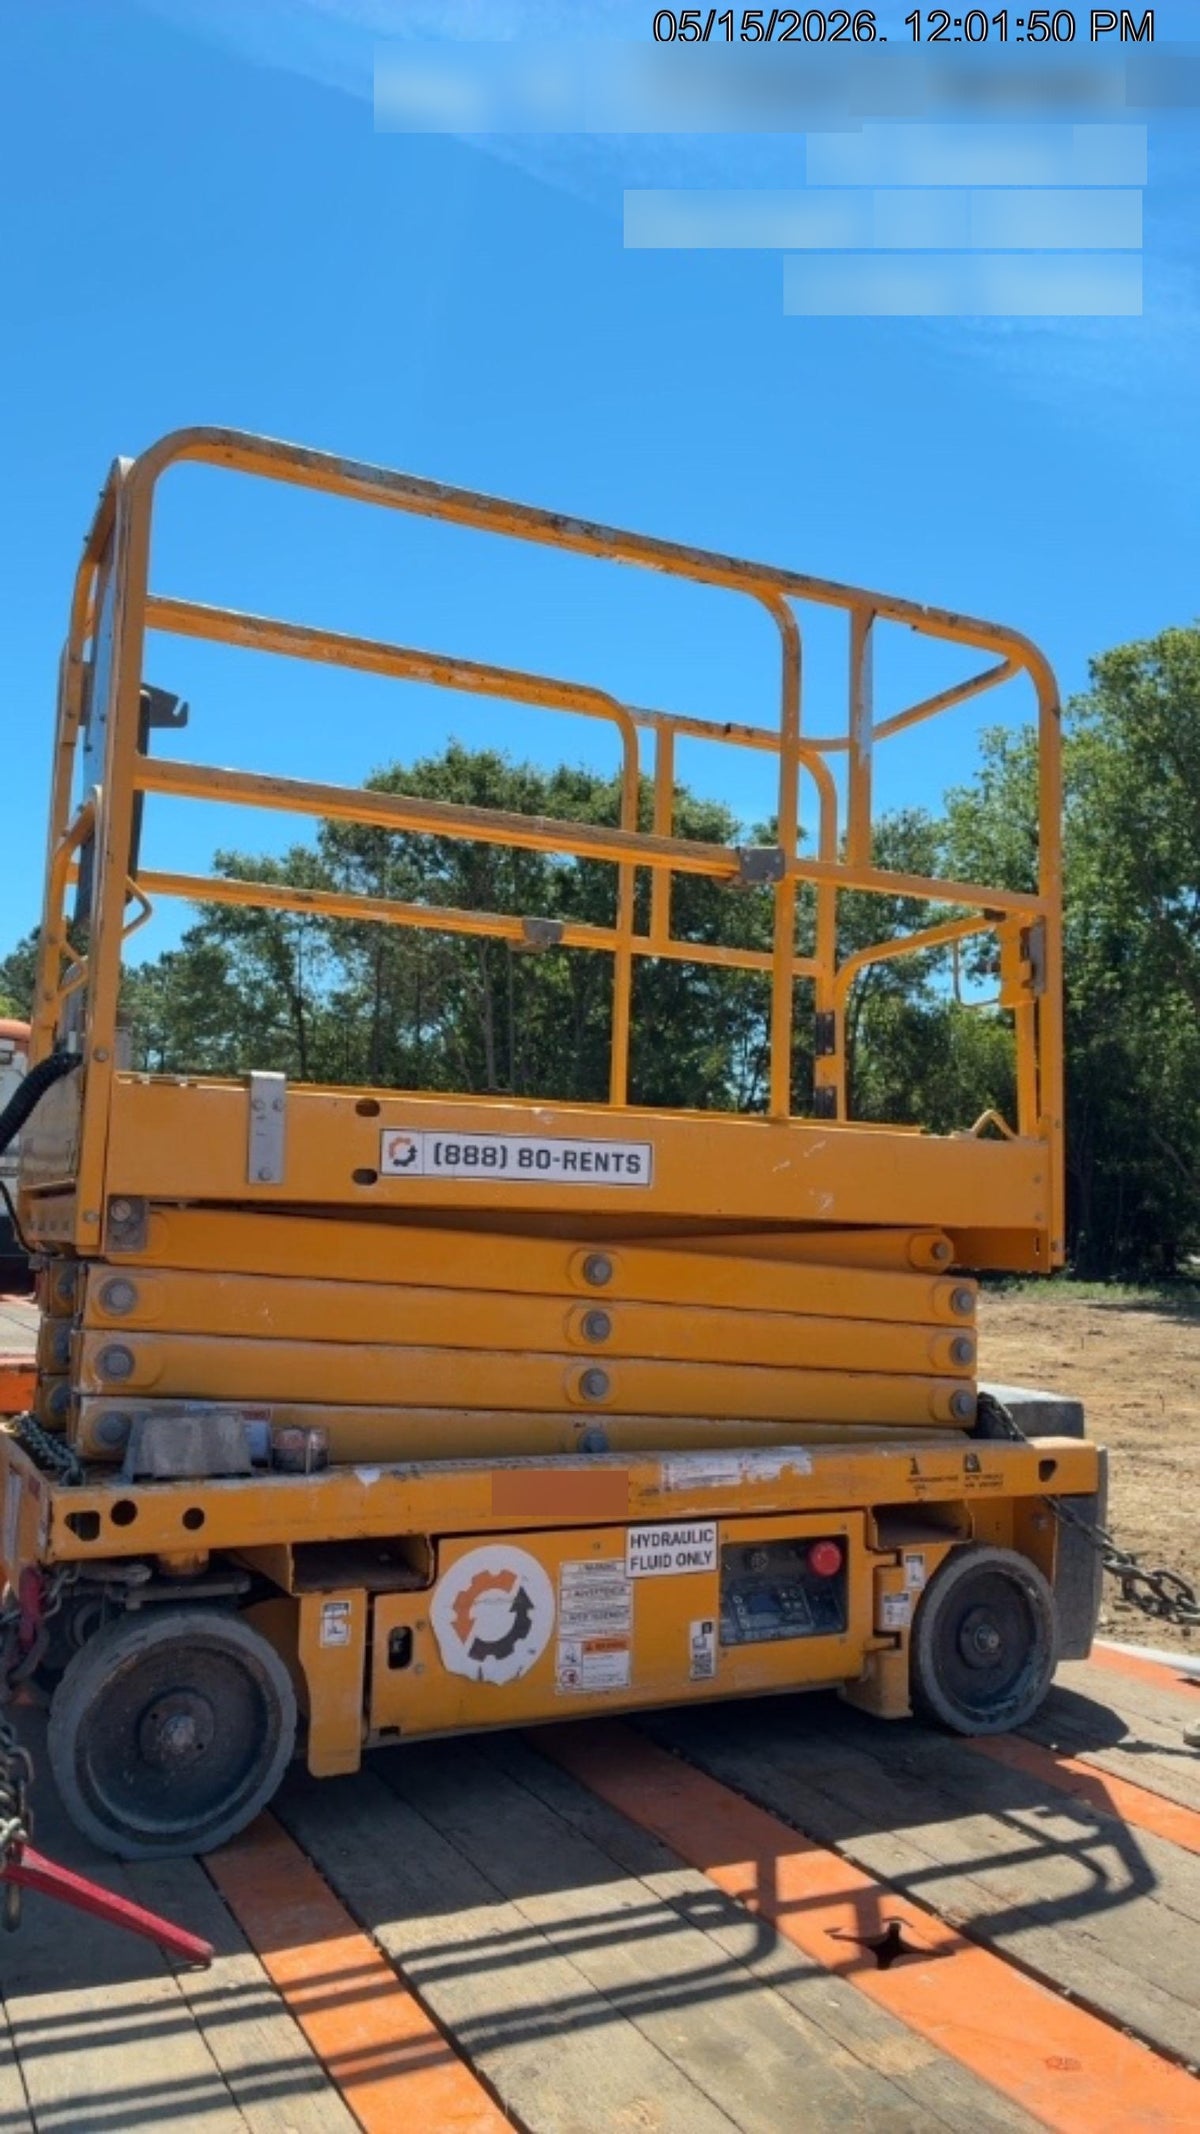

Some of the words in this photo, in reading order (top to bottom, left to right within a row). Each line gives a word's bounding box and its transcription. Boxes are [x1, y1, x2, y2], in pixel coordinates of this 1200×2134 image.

[434, 1142, 508, 1169] (888)
[630, 1529, 714, 1548] HYDRAULIC
[630, 1553, 672, 1570] FLUID
[675, 1550, 712, 1567] ONLY
